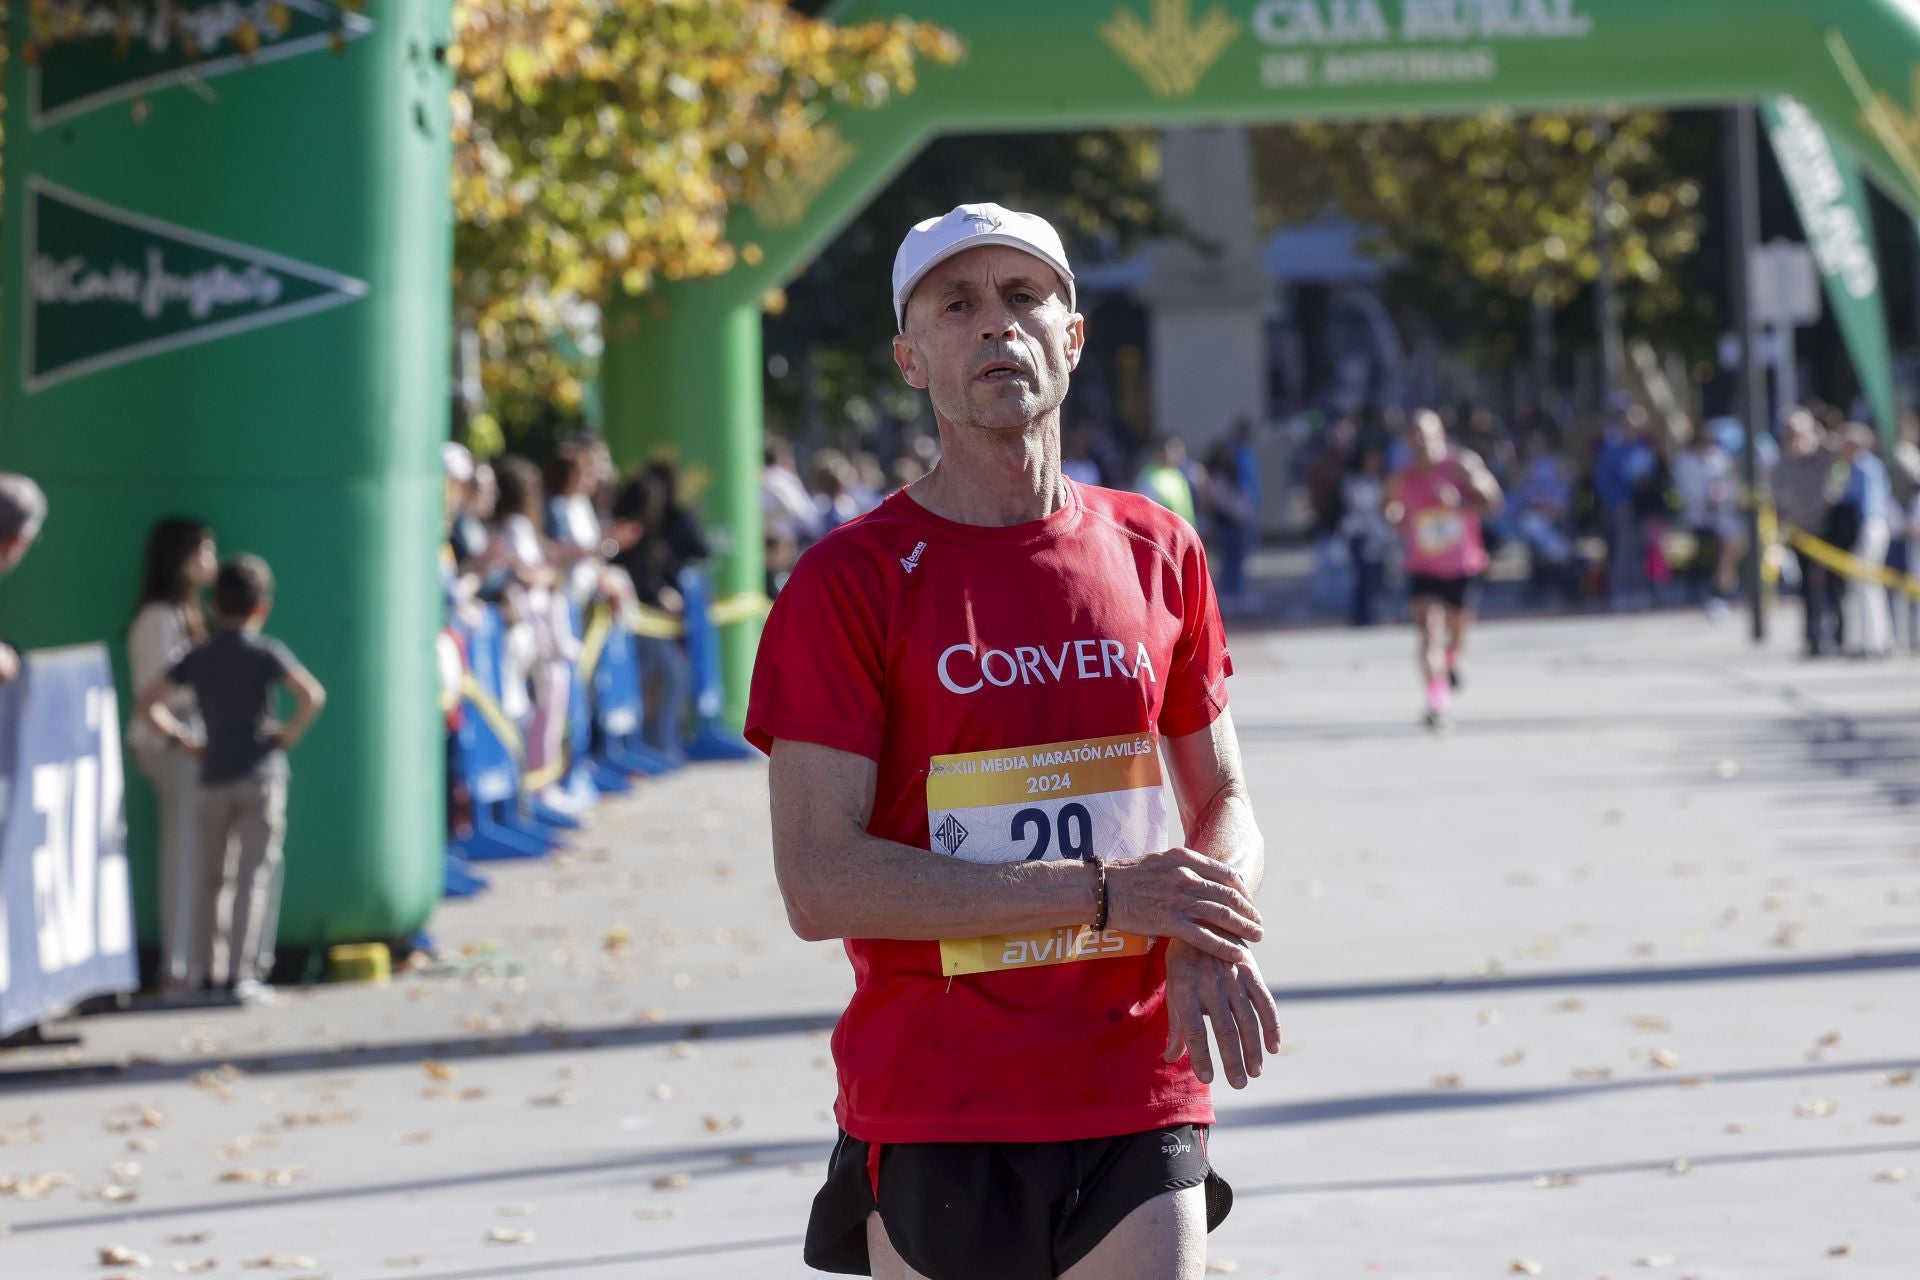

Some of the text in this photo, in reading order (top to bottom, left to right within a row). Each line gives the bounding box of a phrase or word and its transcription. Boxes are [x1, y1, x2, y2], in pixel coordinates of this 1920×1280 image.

[1253, 0, 1592, 43] CAJA RURAL
[980, 755, 1029, 774] MEDIA
[1032, 744, 1101, 768] MARATÓN
[1104, 737, 1151, 759] AVILÉS
[1026, 772, 1072, 794] 2024
[1011, 802, 1095, 861] 29
